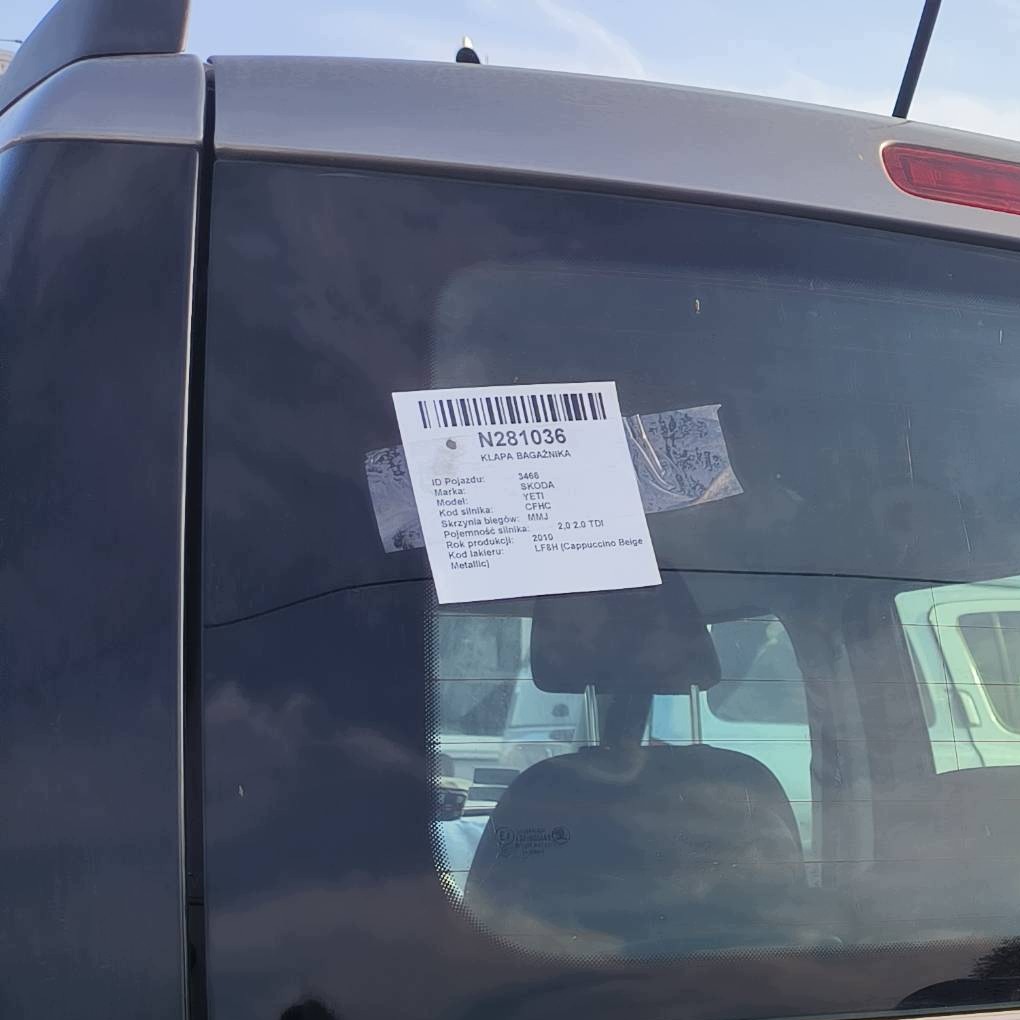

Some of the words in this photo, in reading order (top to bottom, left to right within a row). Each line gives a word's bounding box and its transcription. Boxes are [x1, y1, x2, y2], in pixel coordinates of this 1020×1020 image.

[478, 428, 567, 448] N281036
[481, 453, 514, 462] KLAPA
[516, 448, 571, 460] BAGAŻNIKA
[434, 488, 465, 496] Marka:
[520, 481, 555, 490] SKODA
[445, 476, 485, 487] Pojazdu:
[437, 498, 468, 506] Model:
[523, 492, 544, 500] YETI
[439, 508, 459, 517] Kod
[461, 506, 494, 514] silnika:
[525, 502, 551, 510] CFHC
[441, 518, 482, 528] Skrzynia
[484, 515, 520, 525] biegów:
[444, 528, 496, 539] Pojemność
[498, 525, 530, 534] silnika:
[573, 521, 586, 529] 2.0
[446, 540, 465, 549] Rok
[468, 537, 514, 548] produkcji:
[532, 533, 554, 542] 2010
[449, 551, 468, 559] Kod
[470, 549, 504, 557] lakieru:
[561, 539, 617, 552] (Cappuccino
[618, 537, 643, 547] Beige
[451, 560, 490, 570] Metallic)
